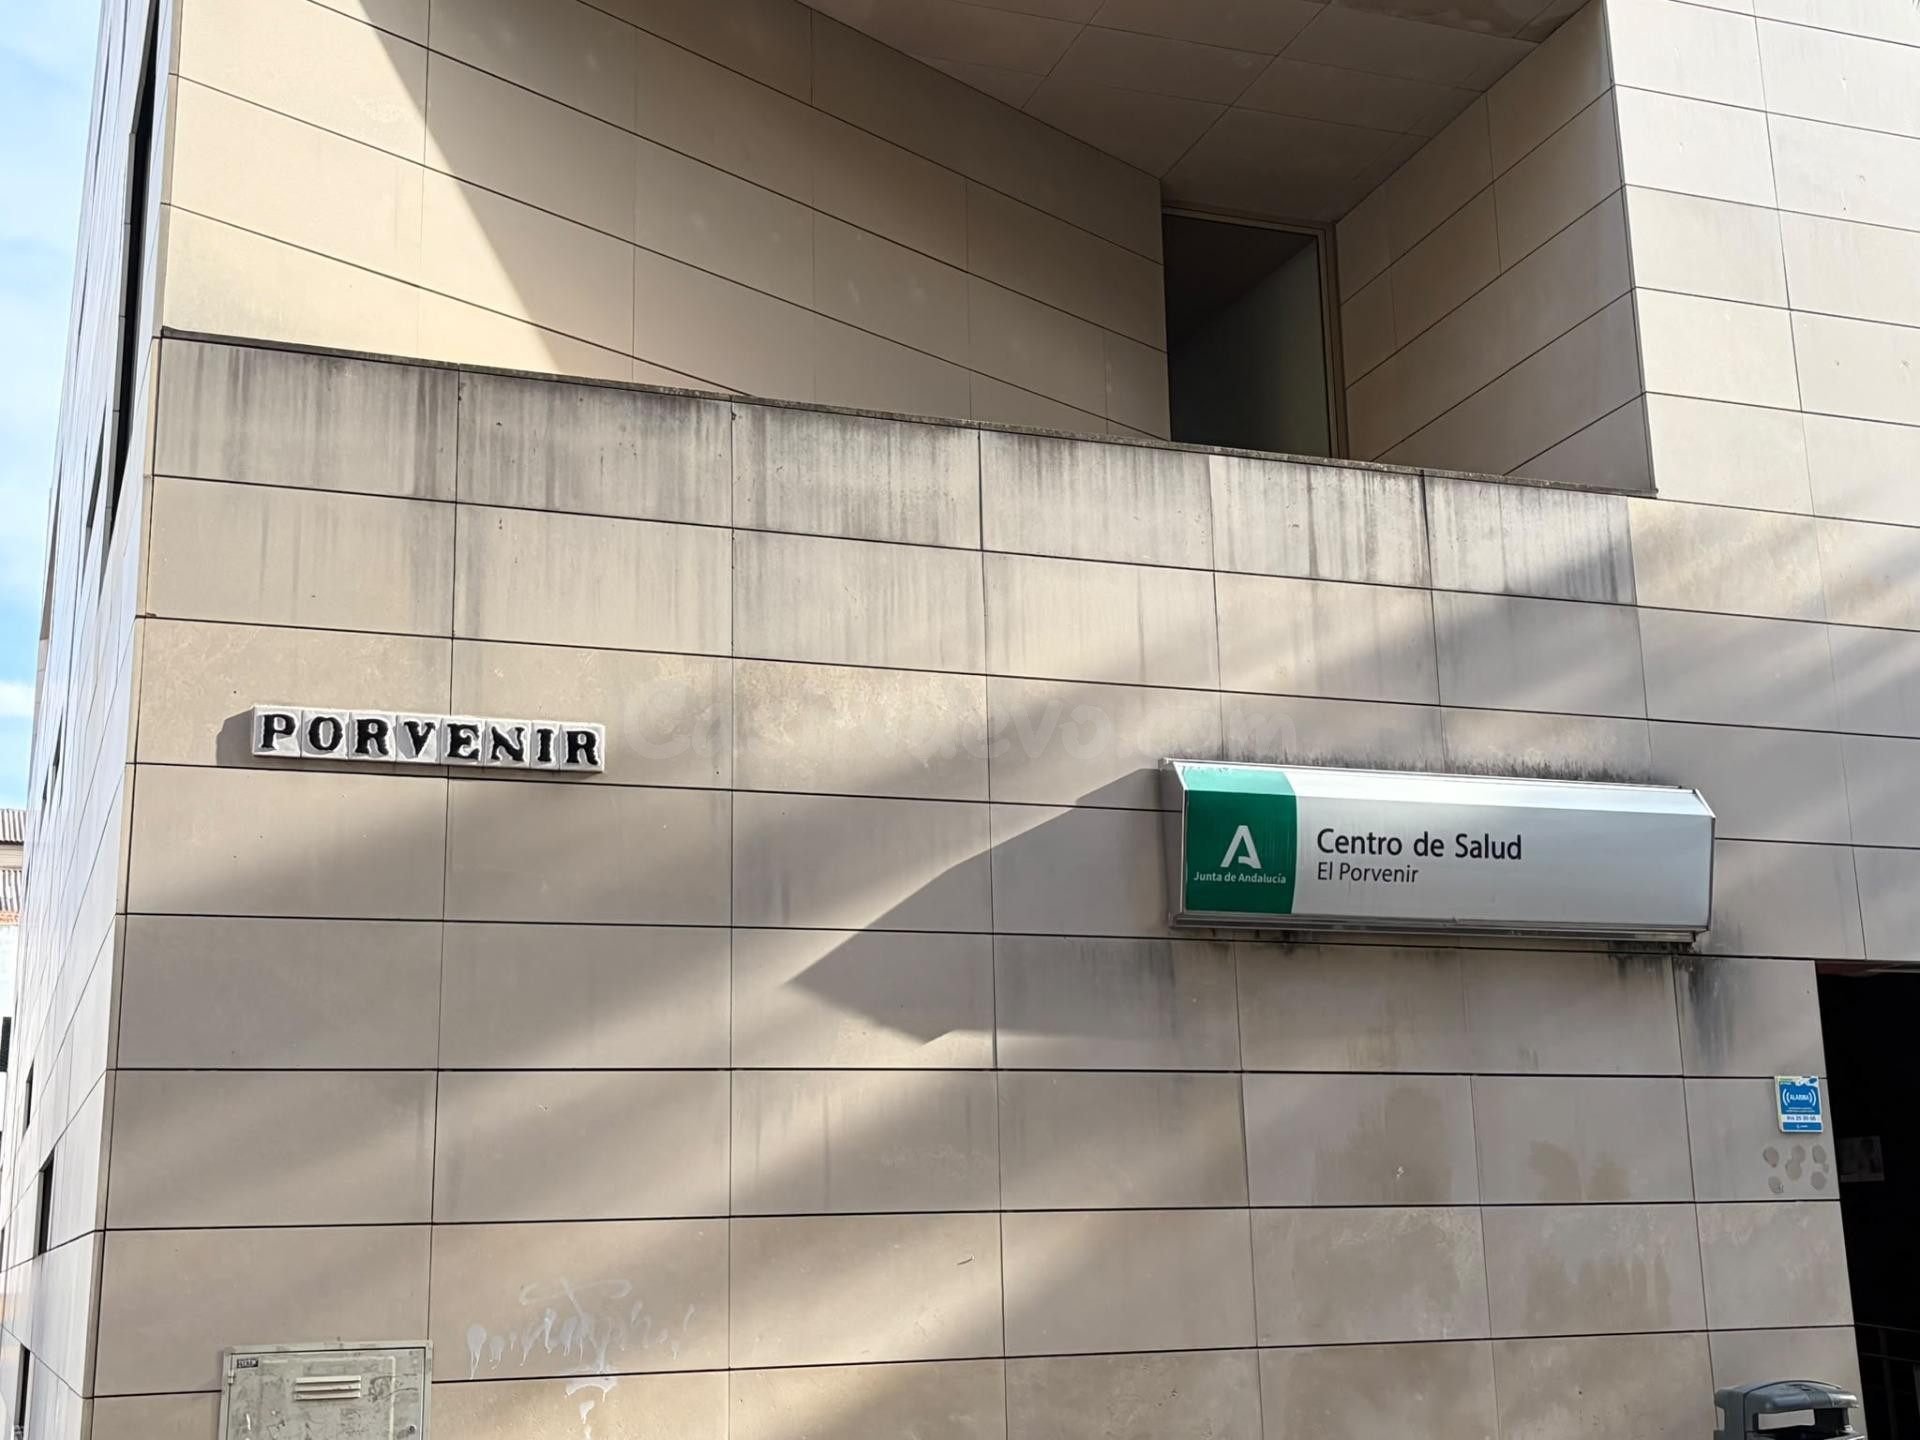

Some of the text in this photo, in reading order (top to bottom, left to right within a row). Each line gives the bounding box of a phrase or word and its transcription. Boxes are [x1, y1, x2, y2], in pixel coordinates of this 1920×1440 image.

[261, 713, 600, 767] PORVENIR
[1317, 828, 1522, 861] Centro de Salud
[1193, 871, 1287, 884] Junta de Andalucía
[1317, 861, 1419, 884] El Porvenir
